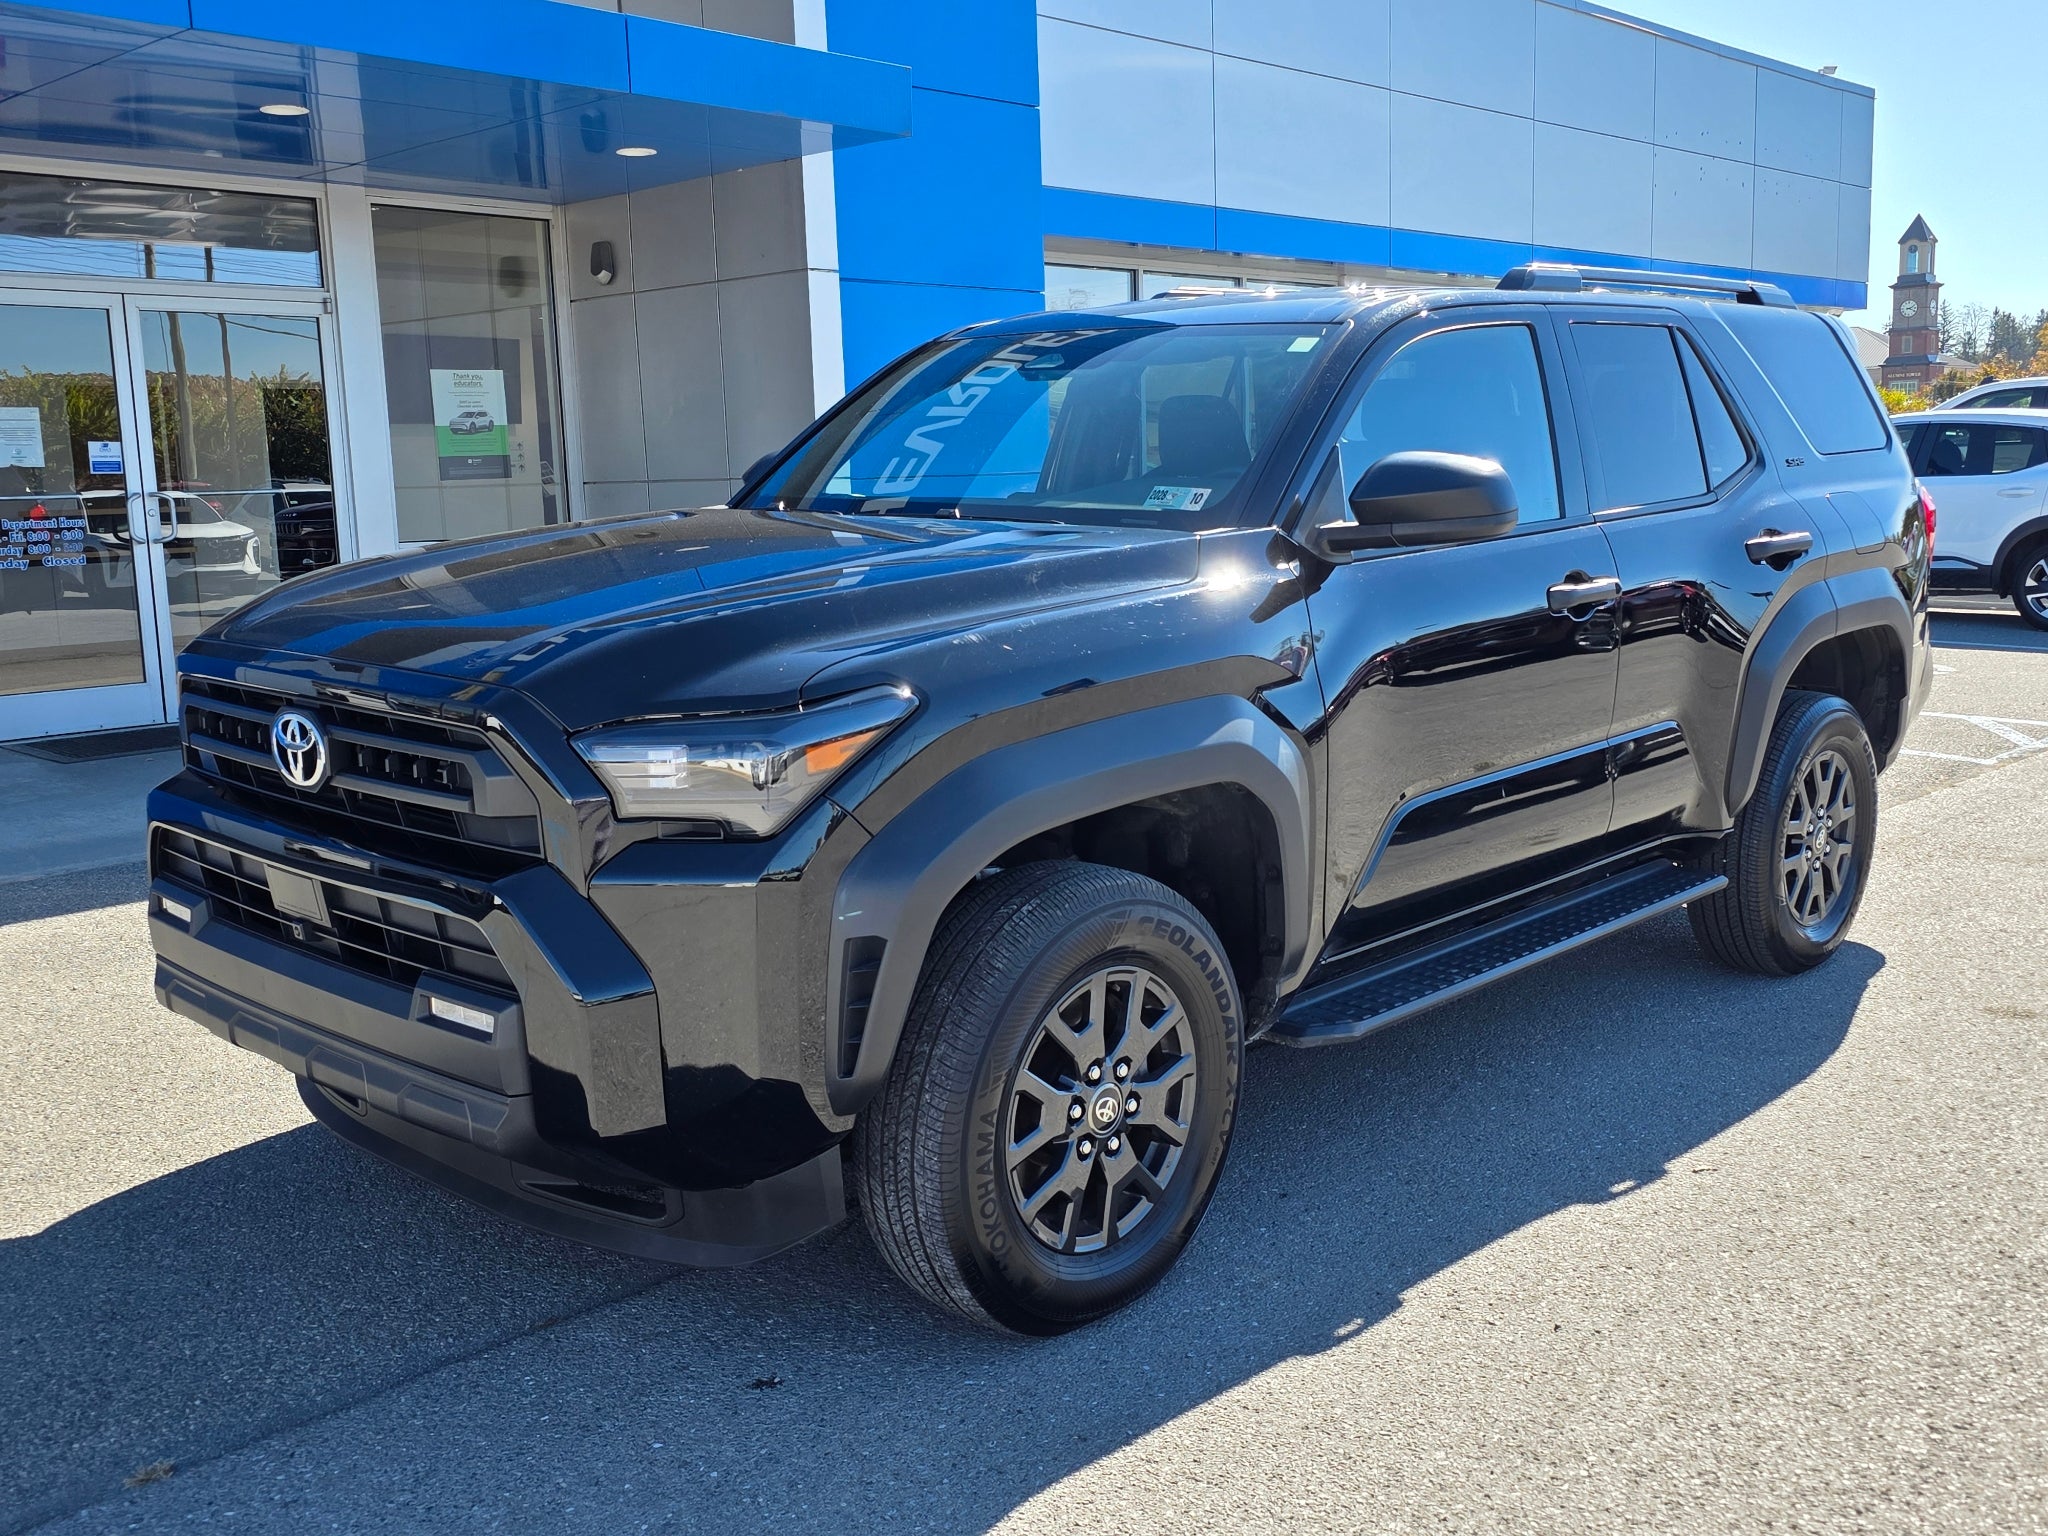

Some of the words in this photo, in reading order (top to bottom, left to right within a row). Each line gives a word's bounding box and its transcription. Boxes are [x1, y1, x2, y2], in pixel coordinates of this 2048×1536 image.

[453, 372, 470, 380] Thank
[1190, 492, 1204, 504] 10
[1, 518, 57, 531] Department
[59, 516, 85, 528] Hours
[9, 531, 26, 542] Fri.
[27, 531, 50, 541] 8:00
[61, 529, 84, 540] 6:00
[28, 543, 51, 554] 8:00
[42, 554, 87, 567] Closed
[1137, 916, 1238, 1066] GEOLANDAR
